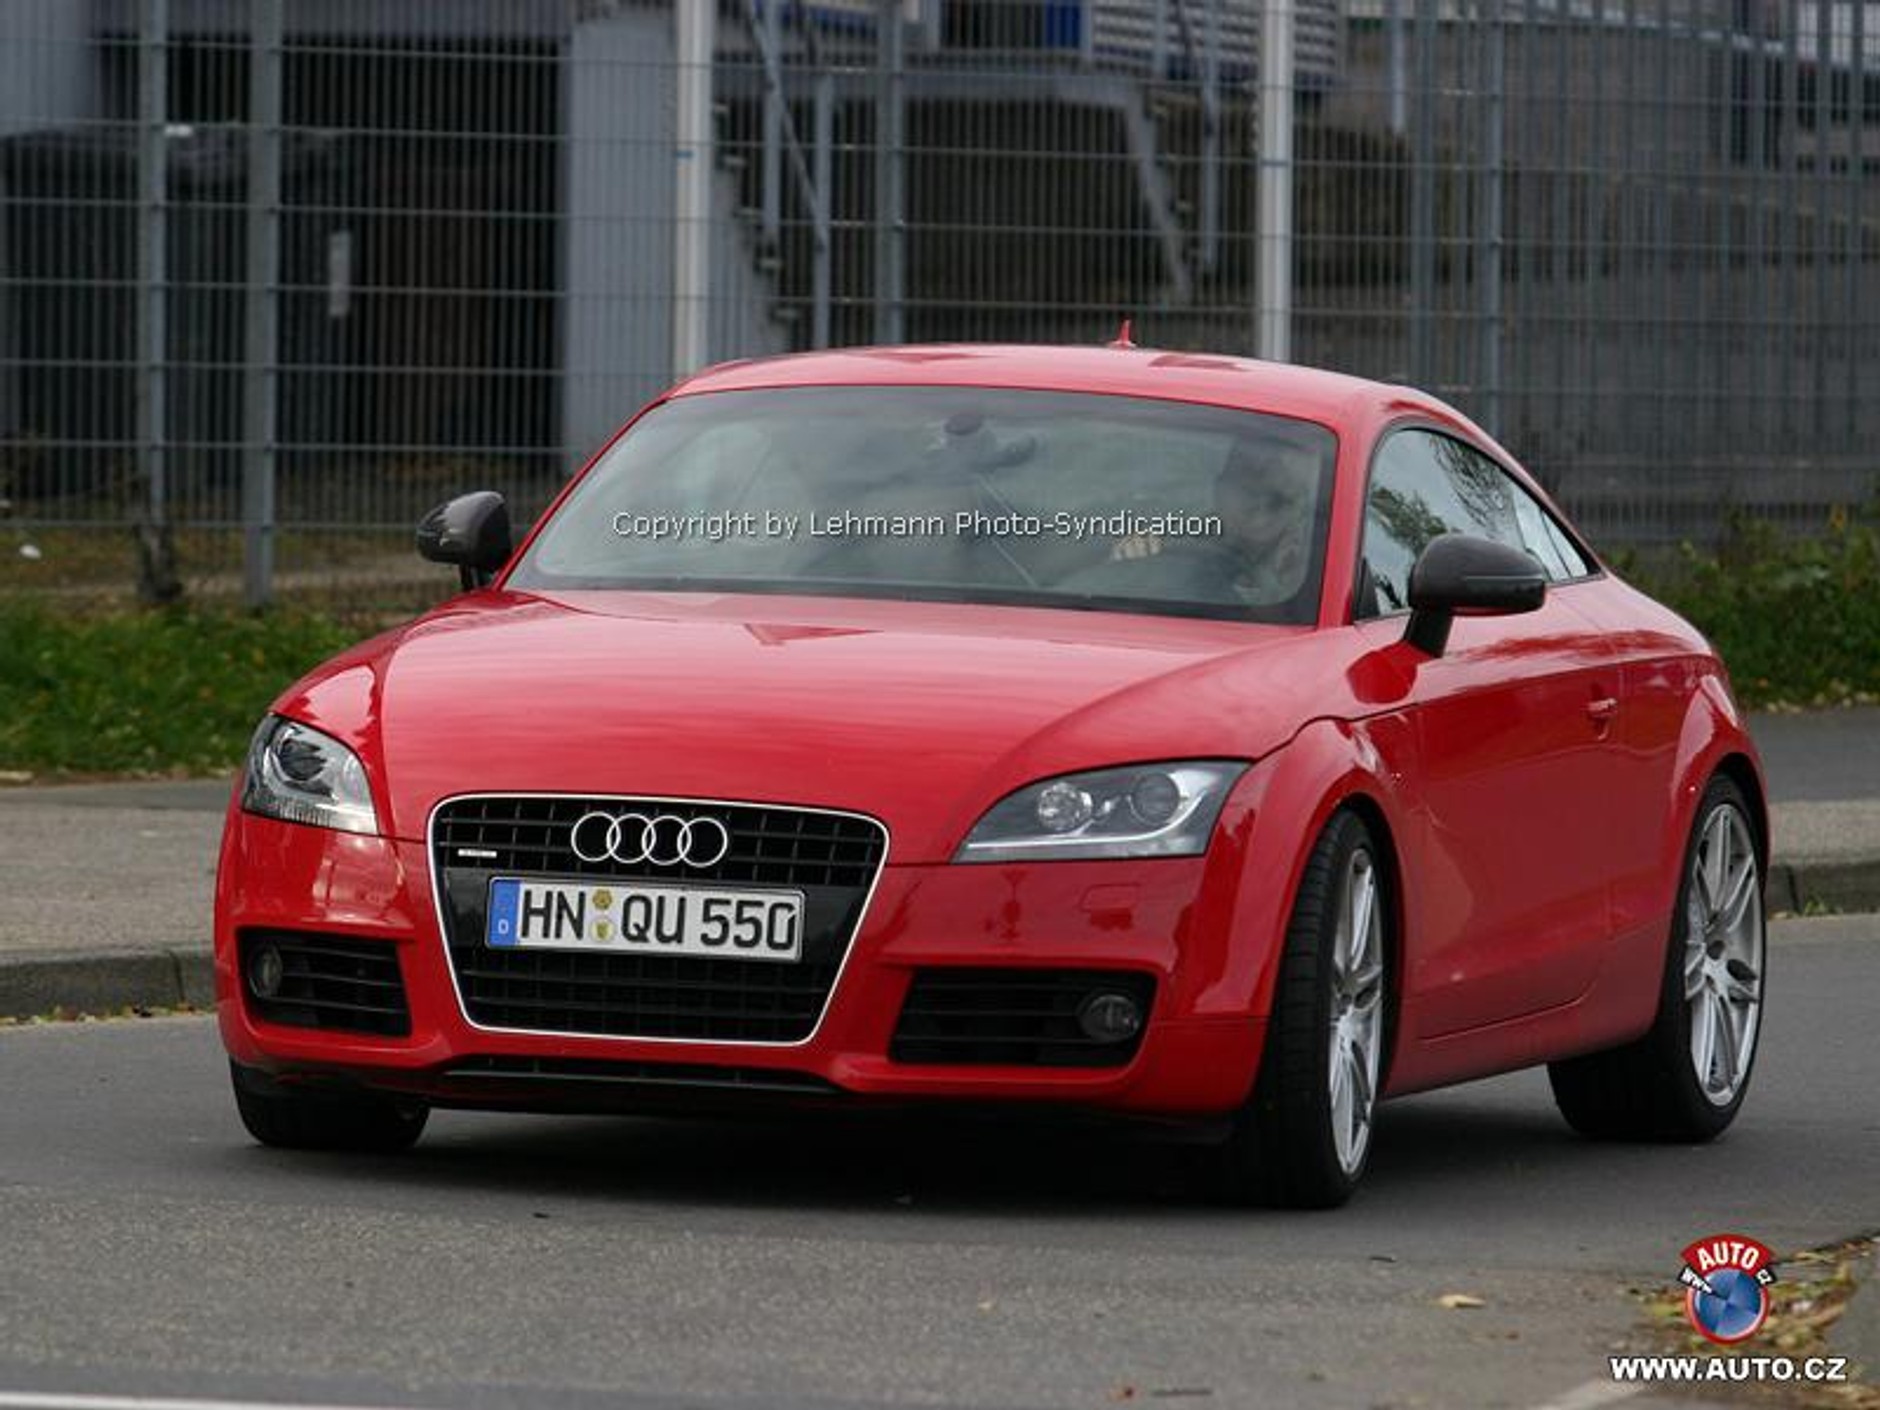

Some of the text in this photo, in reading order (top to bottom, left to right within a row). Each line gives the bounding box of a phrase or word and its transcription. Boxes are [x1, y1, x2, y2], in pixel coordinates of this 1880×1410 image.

[521, 890, 796, 951] HN QU 550
